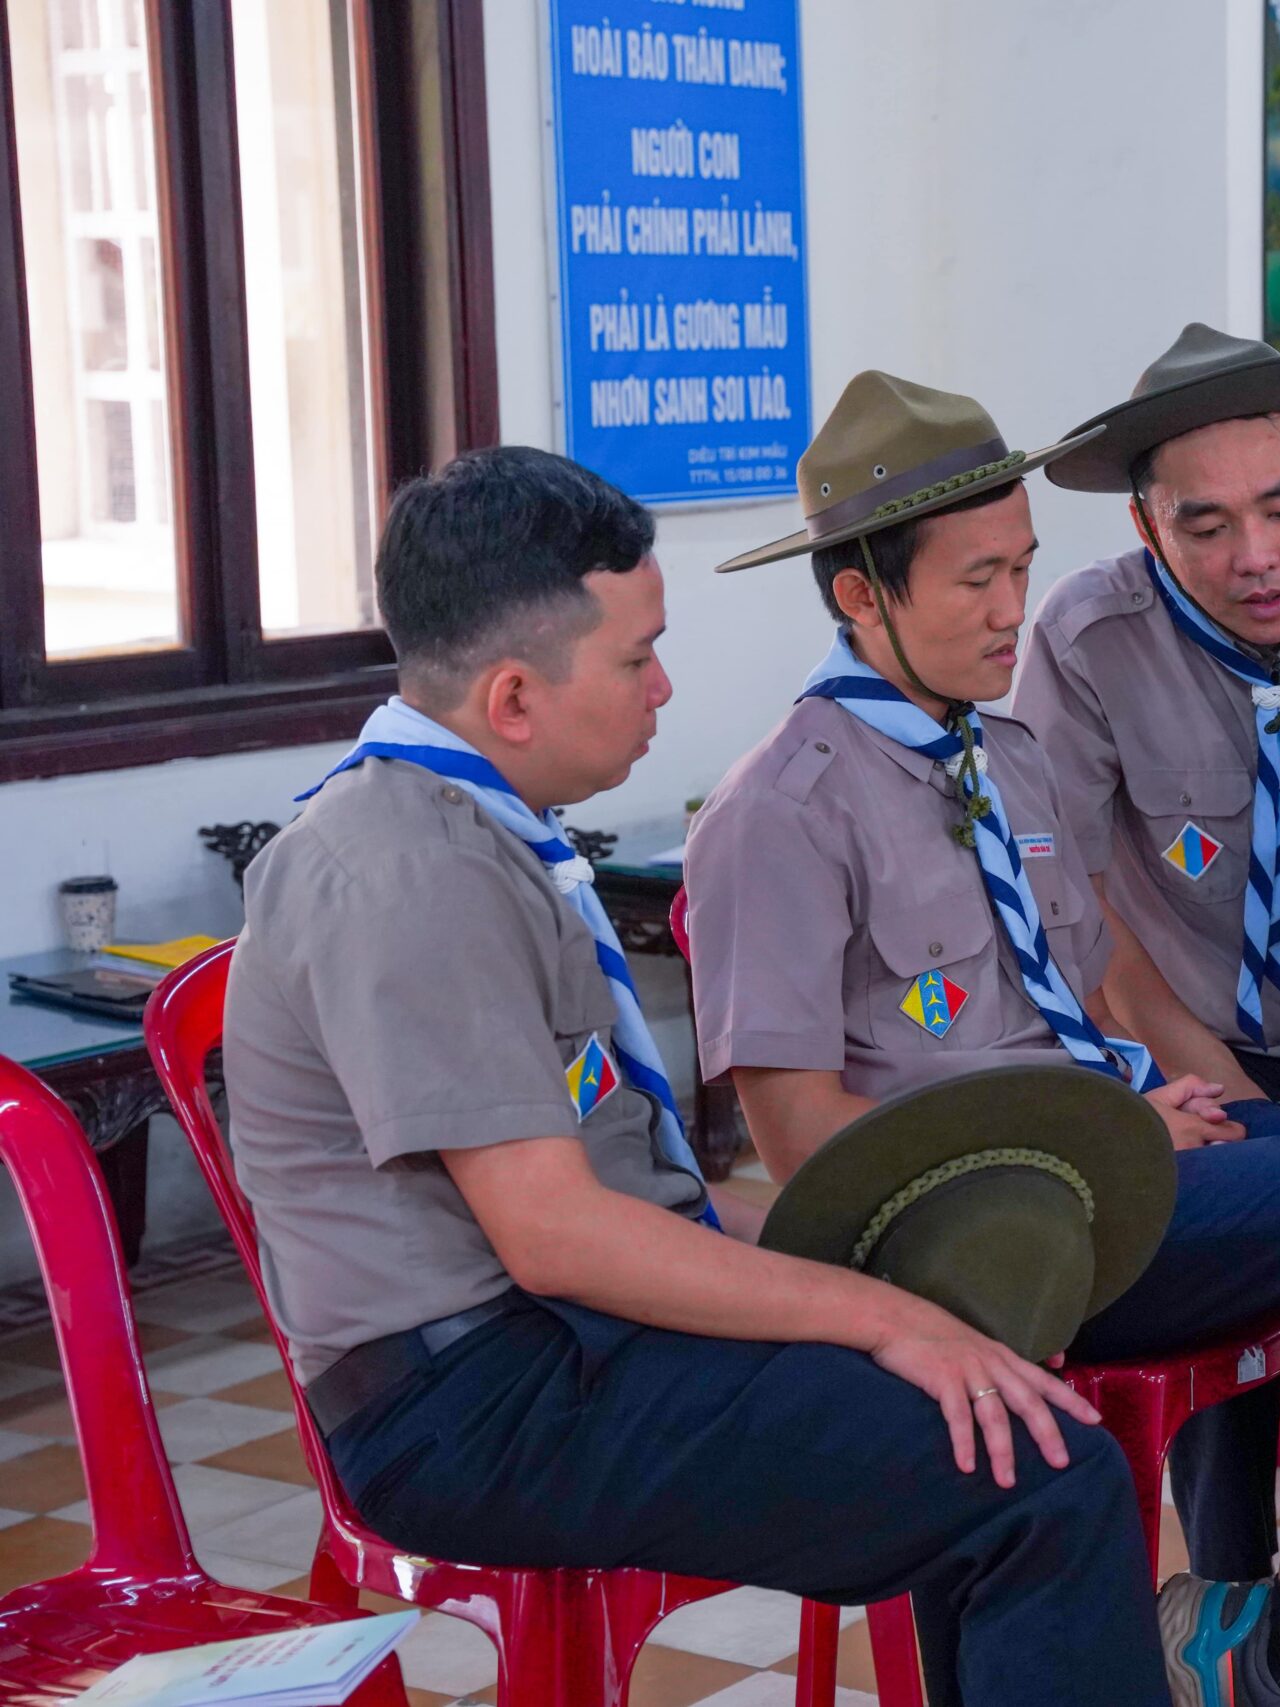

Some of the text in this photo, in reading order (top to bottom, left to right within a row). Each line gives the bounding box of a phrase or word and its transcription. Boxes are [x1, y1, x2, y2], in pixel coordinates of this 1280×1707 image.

[571, 16, 622, 77] HOÀI
[631, 118, 740, 180] NGƯỜI CON
[571, 189, 799, 260] PHẢI CHÍNH PHẢI LÀNH,
[589, 287, 640, 352] PHẢI
[643, 293, 671, 350] LÀ
[673, 299, 740, 349] GƯƠNG
[591, 374, 650, 428] NHƠN
[653, 376, 708, 425] SANH
[711, 375, 745, 423] SOI
